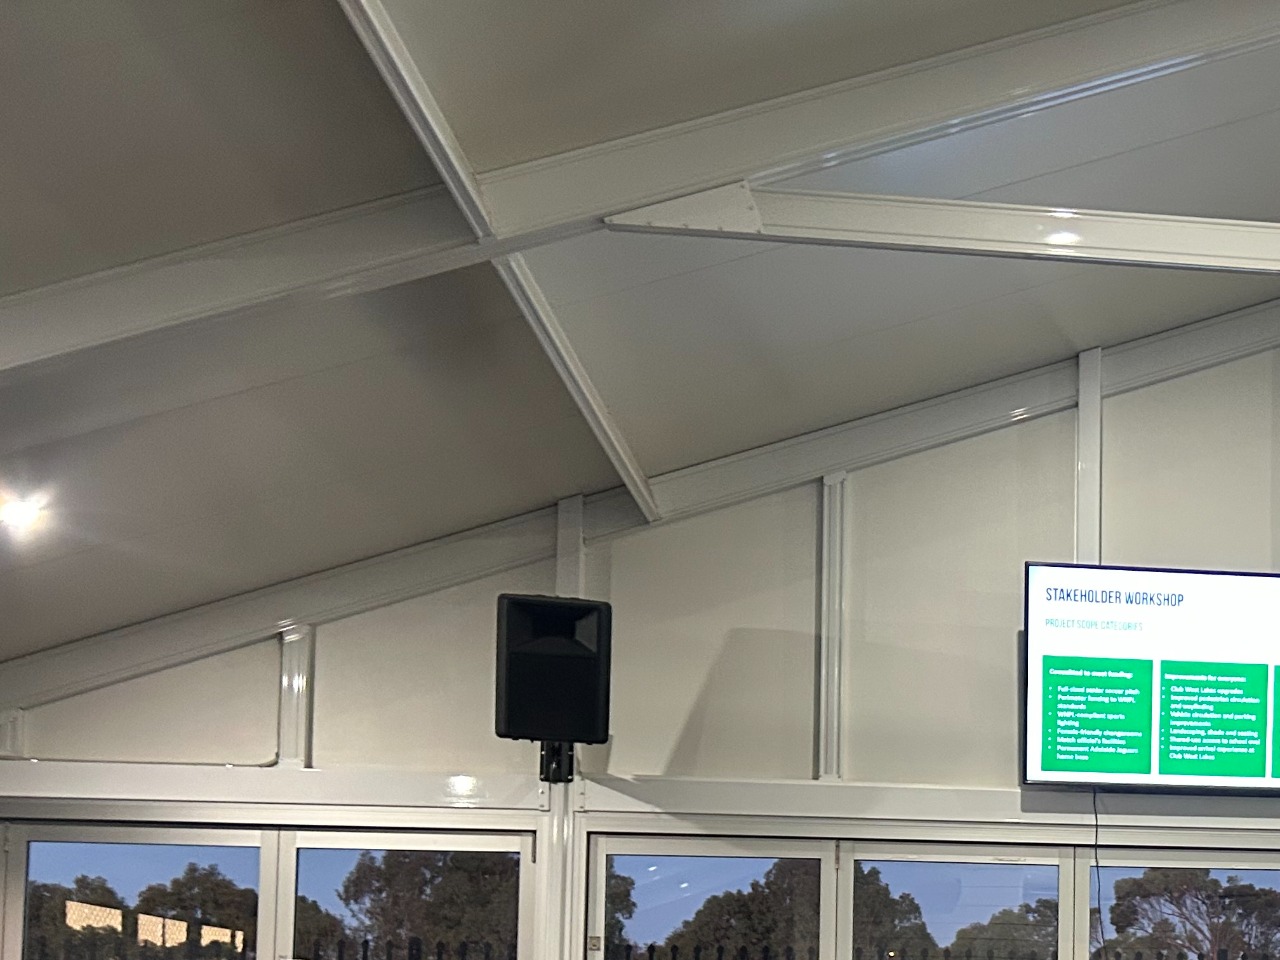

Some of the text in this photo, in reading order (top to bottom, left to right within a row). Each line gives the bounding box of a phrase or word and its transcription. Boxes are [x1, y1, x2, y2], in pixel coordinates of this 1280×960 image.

[1046, 588, 1184, 606] STAKEHOLDER WORKSHOP
[1045, 618, 1074, 628] PROJECT
